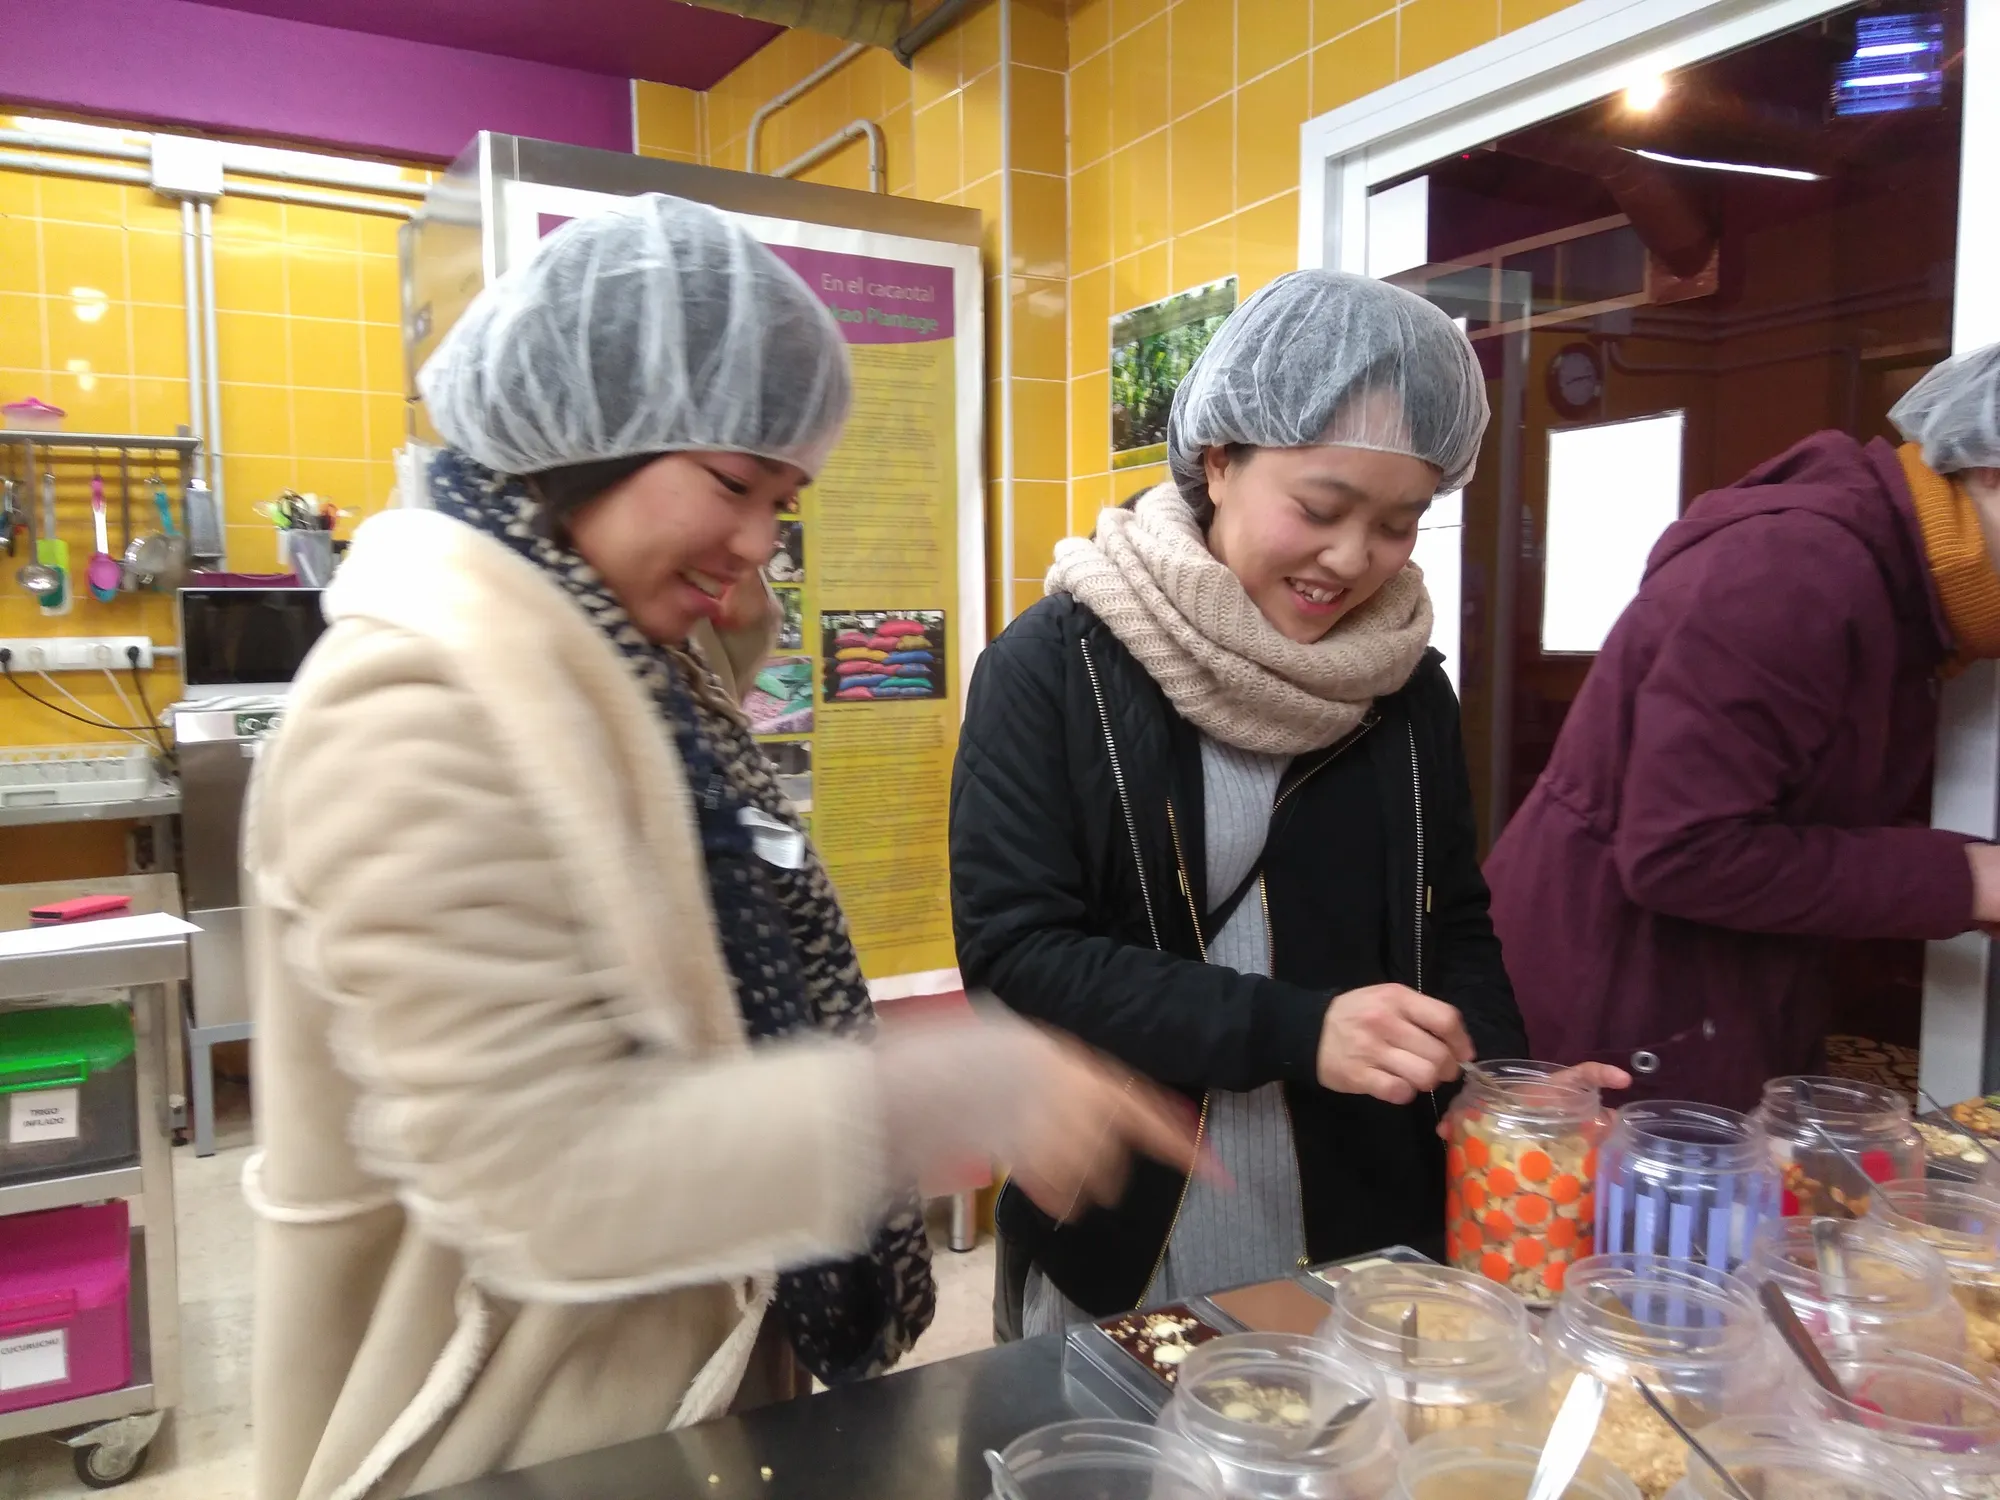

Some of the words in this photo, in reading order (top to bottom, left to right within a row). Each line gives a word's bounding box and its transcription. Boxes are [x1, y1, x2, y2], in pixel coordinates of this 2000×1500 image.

[821, 272, 844, 293] En
[846, 276, 864, 295] el
[867, 282, 935, 303] cacaotal
[866, 306, 939, 335] Plantage
[30, 1107, 59, 1116] TRIGO
